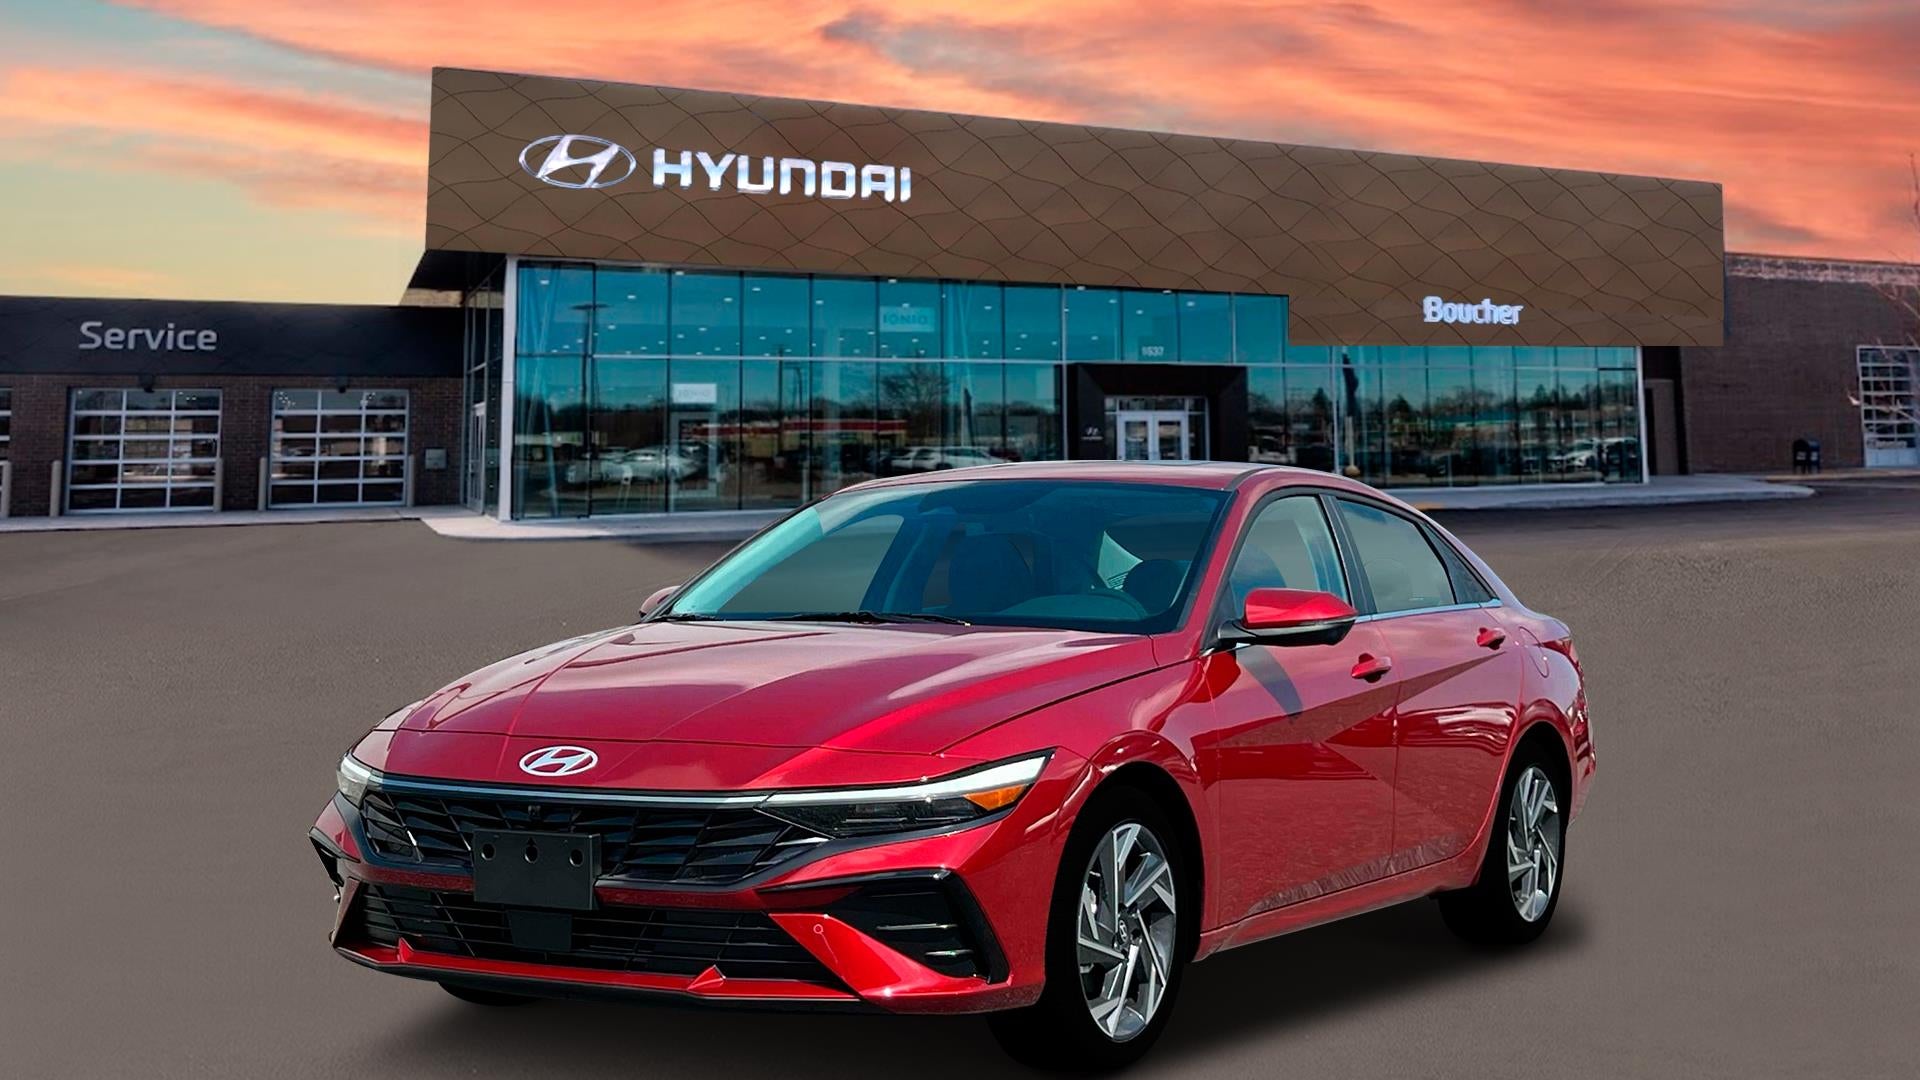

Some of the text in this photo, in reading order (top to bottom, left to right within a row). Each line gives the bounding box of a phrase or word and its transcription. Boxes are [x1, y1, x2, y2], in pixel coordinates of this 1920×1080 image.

[652, 148, 912, 203] HYUNDAI
[1422, 295, 1524, 325] Boucher
[78, 321, 217, 350] Service
